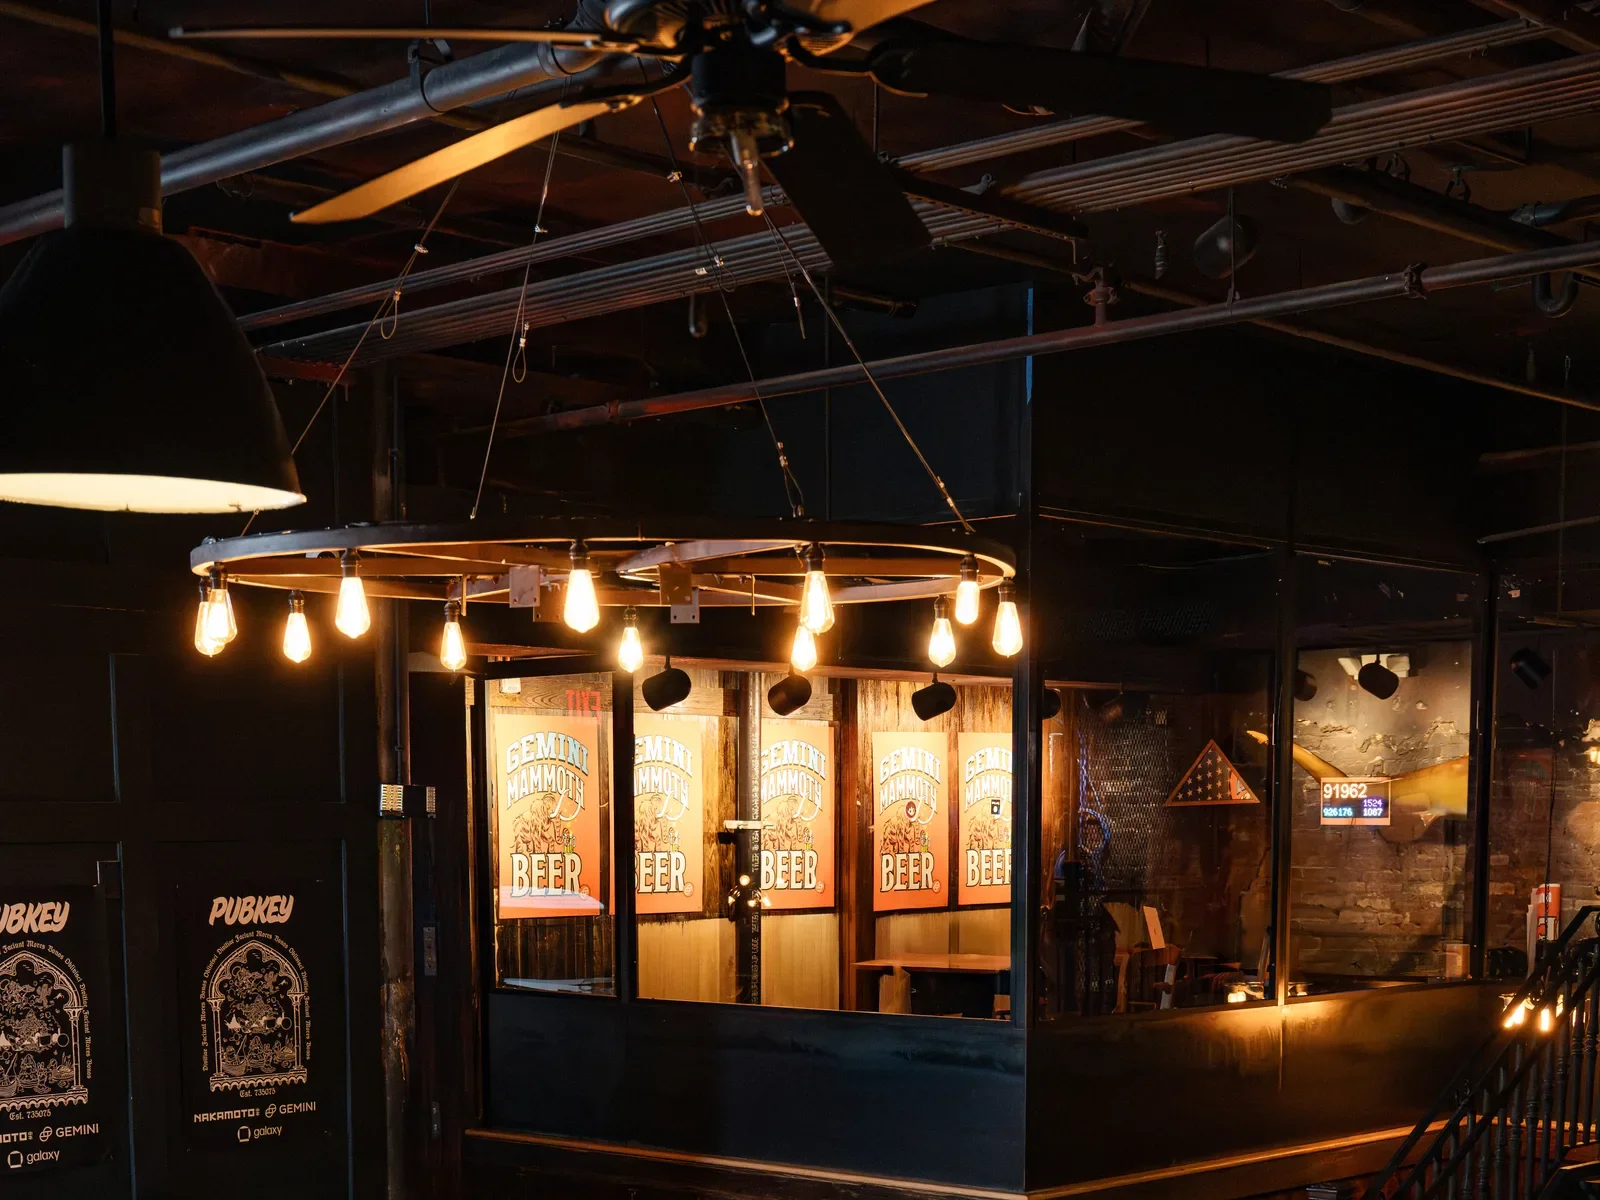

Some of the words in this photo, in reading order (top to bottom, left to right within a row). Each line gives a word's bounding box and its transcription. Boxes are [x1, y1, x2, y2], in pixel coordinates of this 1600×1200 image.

[506, 731, 589, 776] GEMINI
[634, 735, 693, 777] EMINI
[879, 746, 941, 785] GEMINI
[965, 746, 1012, 784] GEMI
[506, 763, 585, 810] MAMMOTH
[634, 765, 690, 810] MMOTH
[879, 774, 938, 815] MAMMOTH
[1323, 783, 1368, 799] 91962
[1363, 799, 1383, 807] 1524
[1323, 807, 1353, 817] 926176
[1363, 807, 1383, 817] 1087
[510, 852, 582, 897] BEER
[634, 851, 687, 894] EER
[761, 850, 818, 890] BEER
[880, 852, 935, 892] BEER
[0, 901, 70, 934] BKEY
[208, 894, 294, 926] PUBKEY
[254, 1088, 276, 1097] 735075
[9, 1111, 24, 1121] Est.
[26, 1109, 52, 1119] 735075
[193, 1108, 256, 1123] NAKAMOTO
[279, 1101, 317, 1115] GEMINI
[55, 1123, 99, 1138] GEMINI
[253, 1126, 283, 1139] galaxy
[26, 1150, 60, 1165] galaxy
